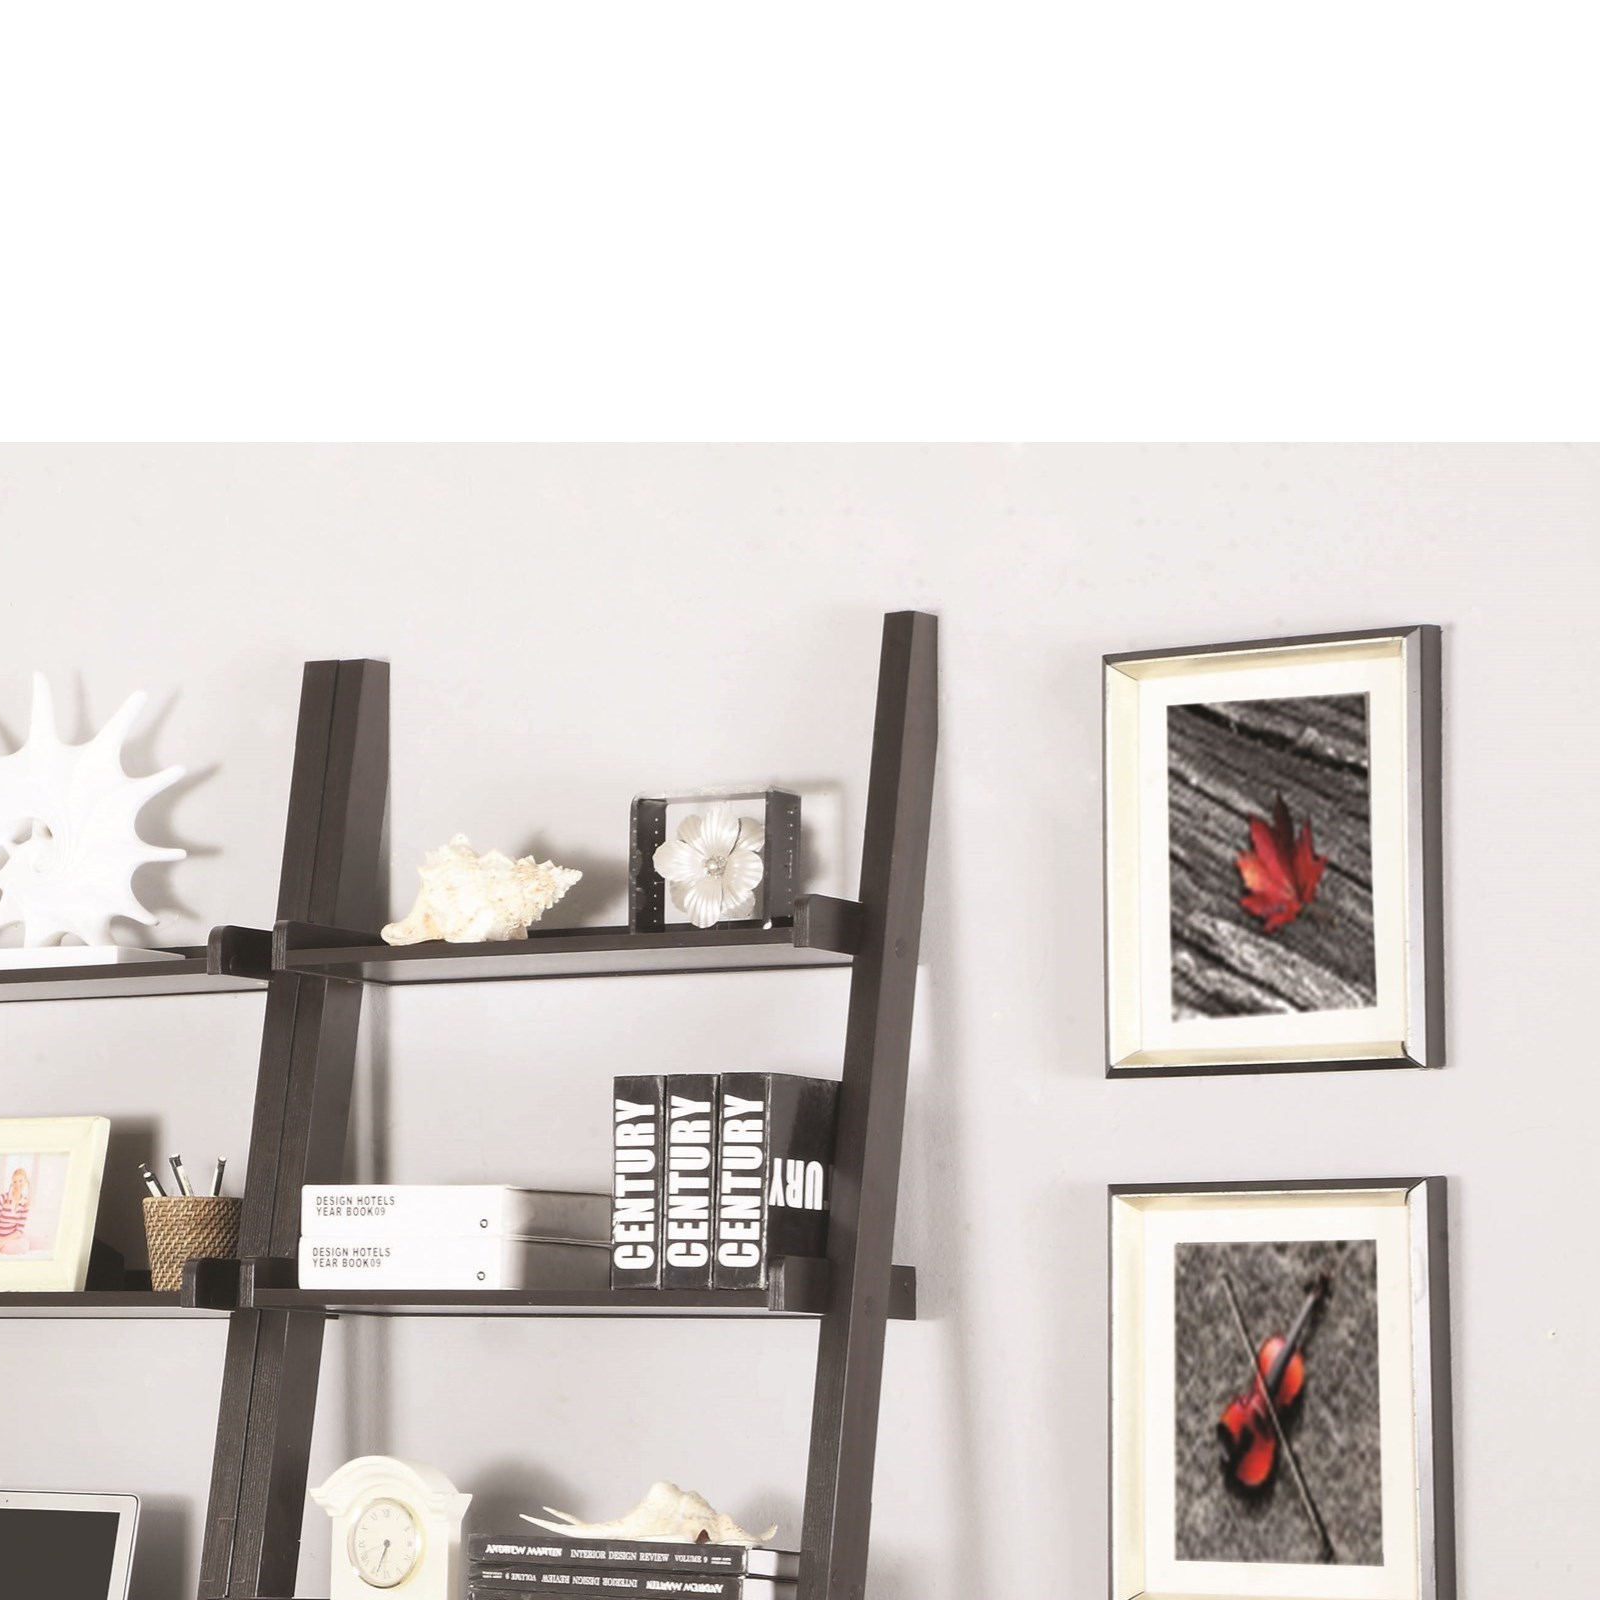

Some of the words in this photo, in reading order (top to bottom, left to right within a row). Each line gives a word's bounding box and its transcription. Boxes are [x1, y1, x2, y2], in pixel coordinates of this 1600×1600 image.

[613, 1098, 656, 1270] CENTURY
[666, 1095, 711, 1268] CENTURY
[717, 1094, 764, 1268] CENTURY
[316, 1196, 353, 1206] DESIGN
[357, 1196, 396, 1206] HOTELS
[316, 1207, 342, 1216] YEAR
[312, 1247, 349, 1257] DESIGN
[352, 1247, 391, 1257] HOTELS
[312, 1258, 338, 1268] YEAR
[485, 1544, 526, 1555] ANDREW
[526, 1546, 563, 1557] MARTIN
[570, 1549, 606, 1559] INTERIOR
[608, 1551, 637, 1561] DESIGN
[639, 1552, 670, 1562] REVIEW
[674, 1554, 702, 1563] VOLUME
[504, 1572, 510, 1580] 9
[510, 1572, 537, 1581] VOLUME
[541, 1574, 570, 1584] REVIEW
[572, 1575, 600, 1586] DESIGN
[602, 1577, 638, 1588] INTERIOR
[645, 1580, 683, 1591] MARTIN
[683, 1582, 724, 1593] ANDREW
